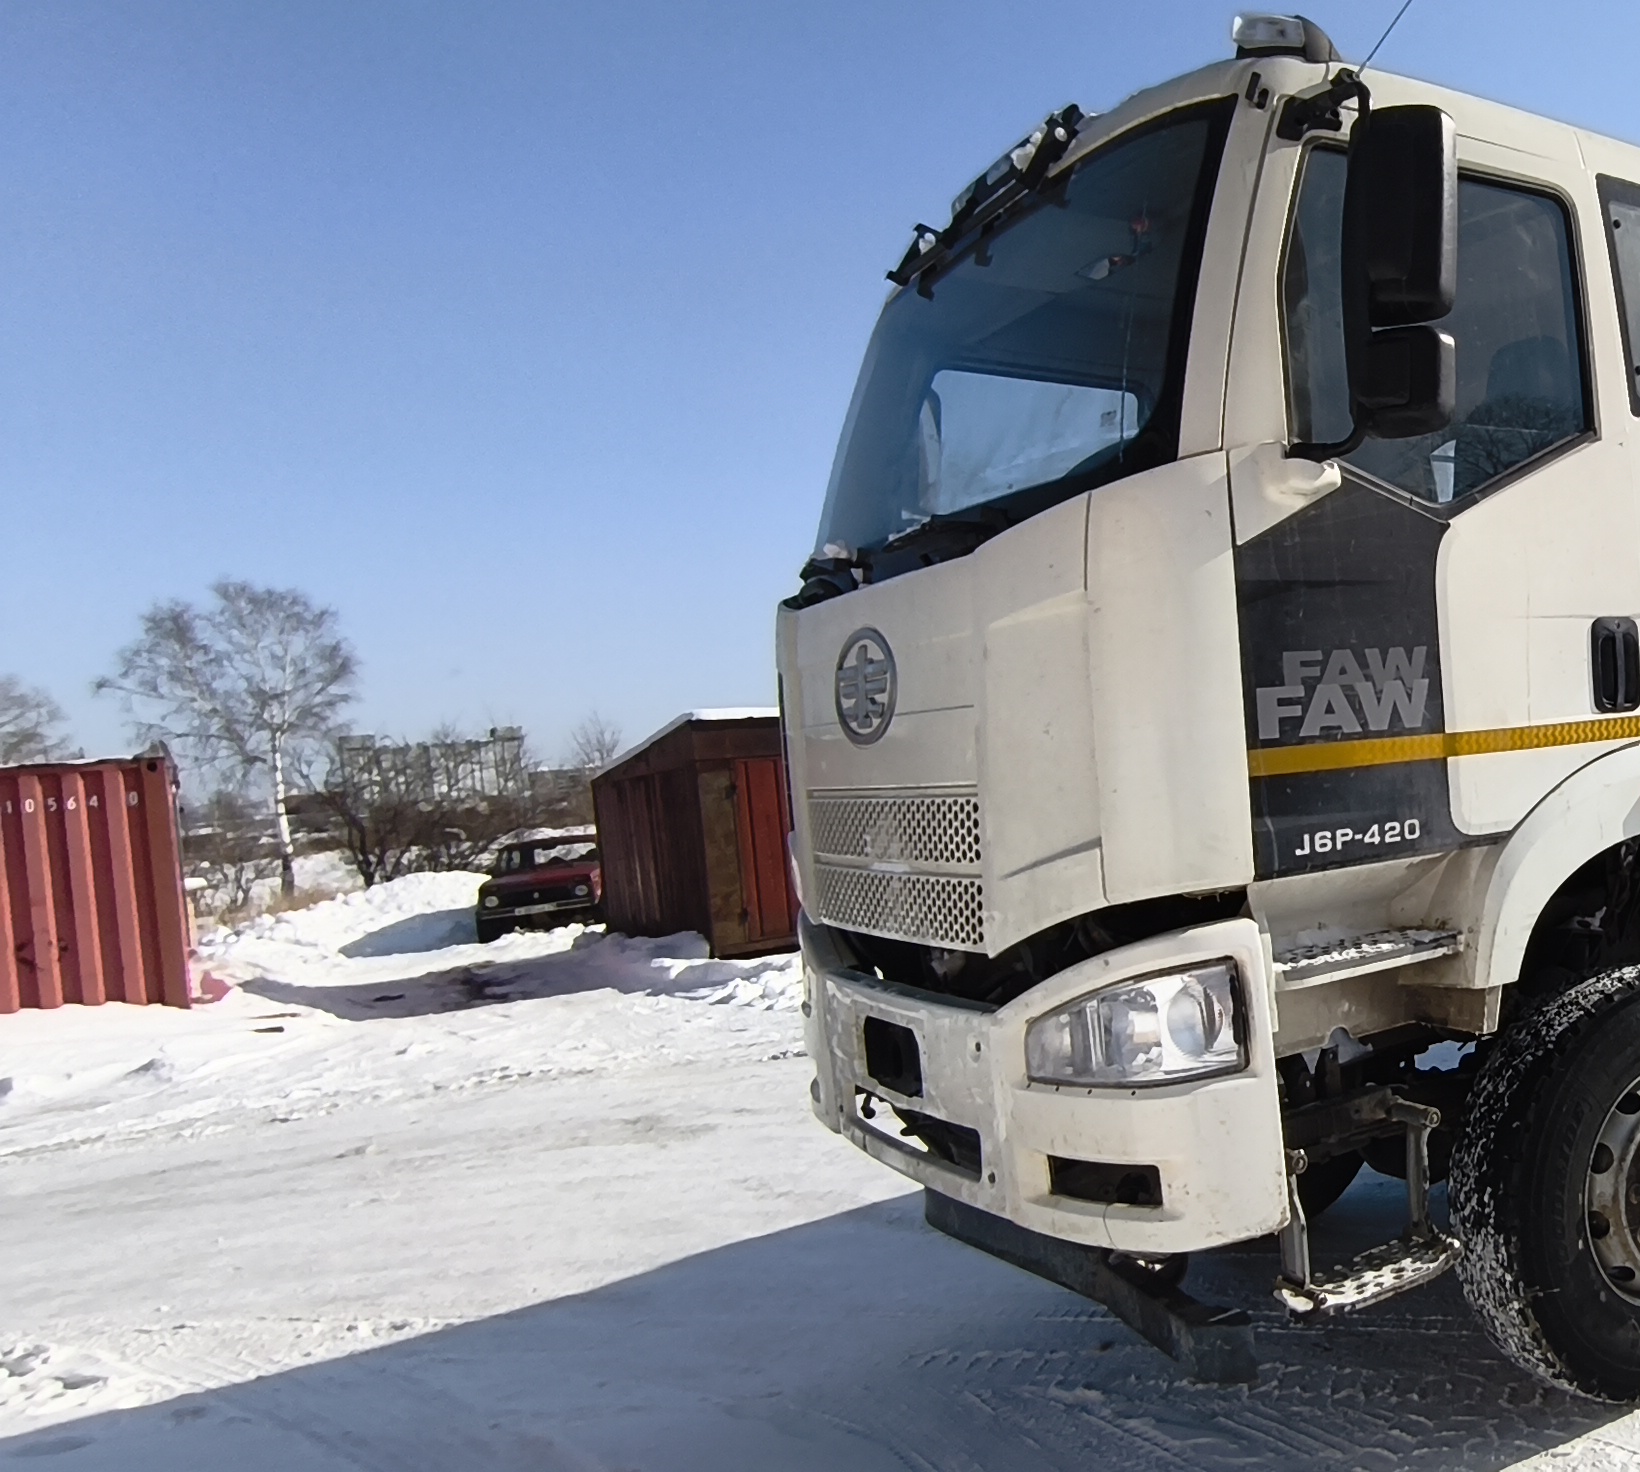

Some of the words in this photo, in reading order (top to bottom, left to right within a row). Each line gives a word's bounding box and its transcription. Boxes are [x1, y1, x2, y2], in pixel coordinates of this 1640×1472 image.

[1282, 646, 1427, 690] FAW
[1256, 679, 1429, 740] FAW
[1295, 819, 1421, 856] J6P-420
